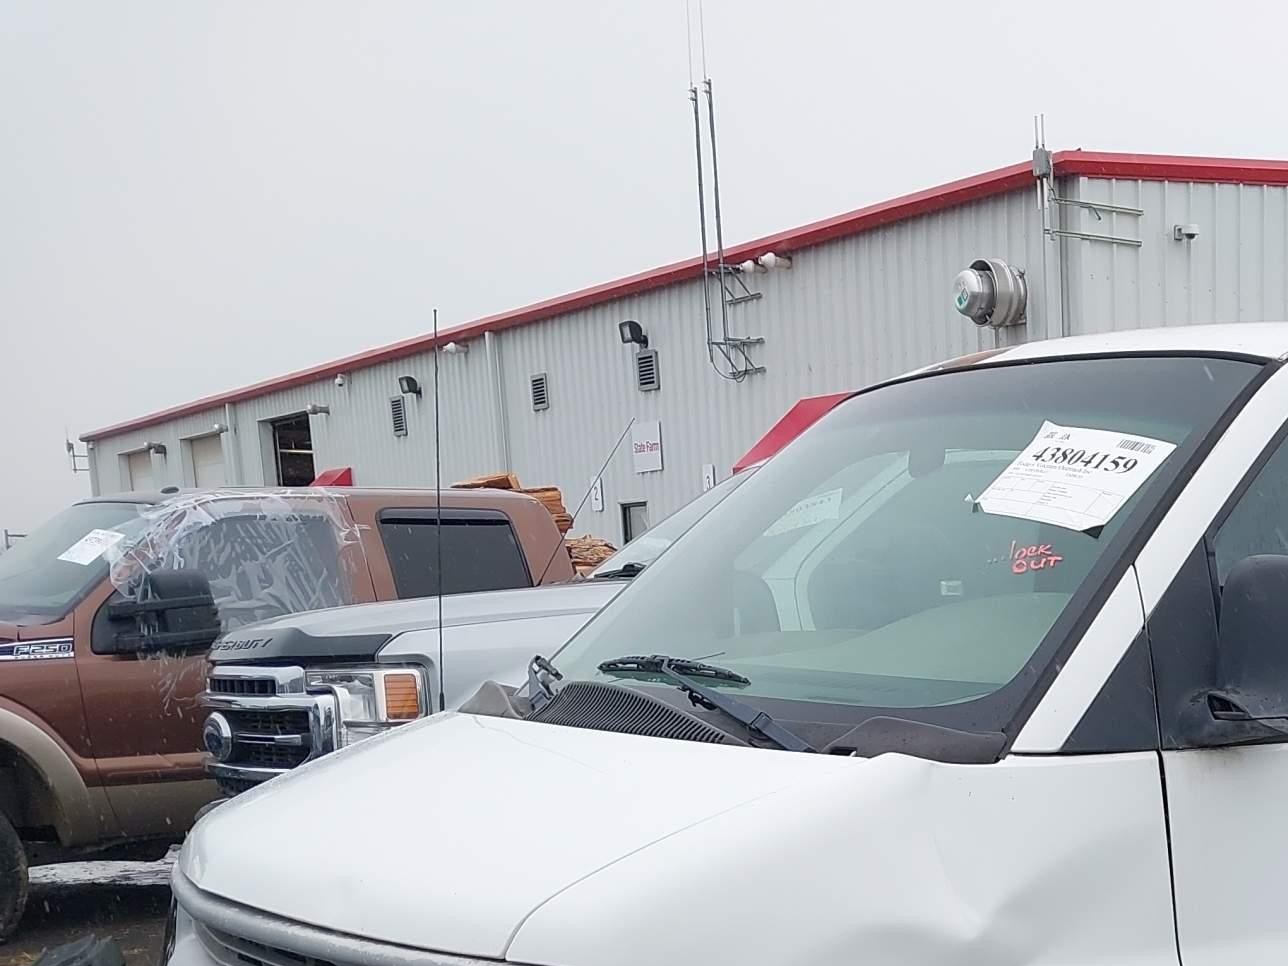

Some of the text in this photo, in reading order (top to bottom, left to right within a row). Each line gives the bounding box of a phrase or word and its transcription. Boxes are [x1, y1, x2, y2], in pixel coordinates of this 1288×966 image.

[646, 440, 660, 453] Farm
[1032, 446, 1139, 474] 43804159
[593, 486, 599, 501] 2
